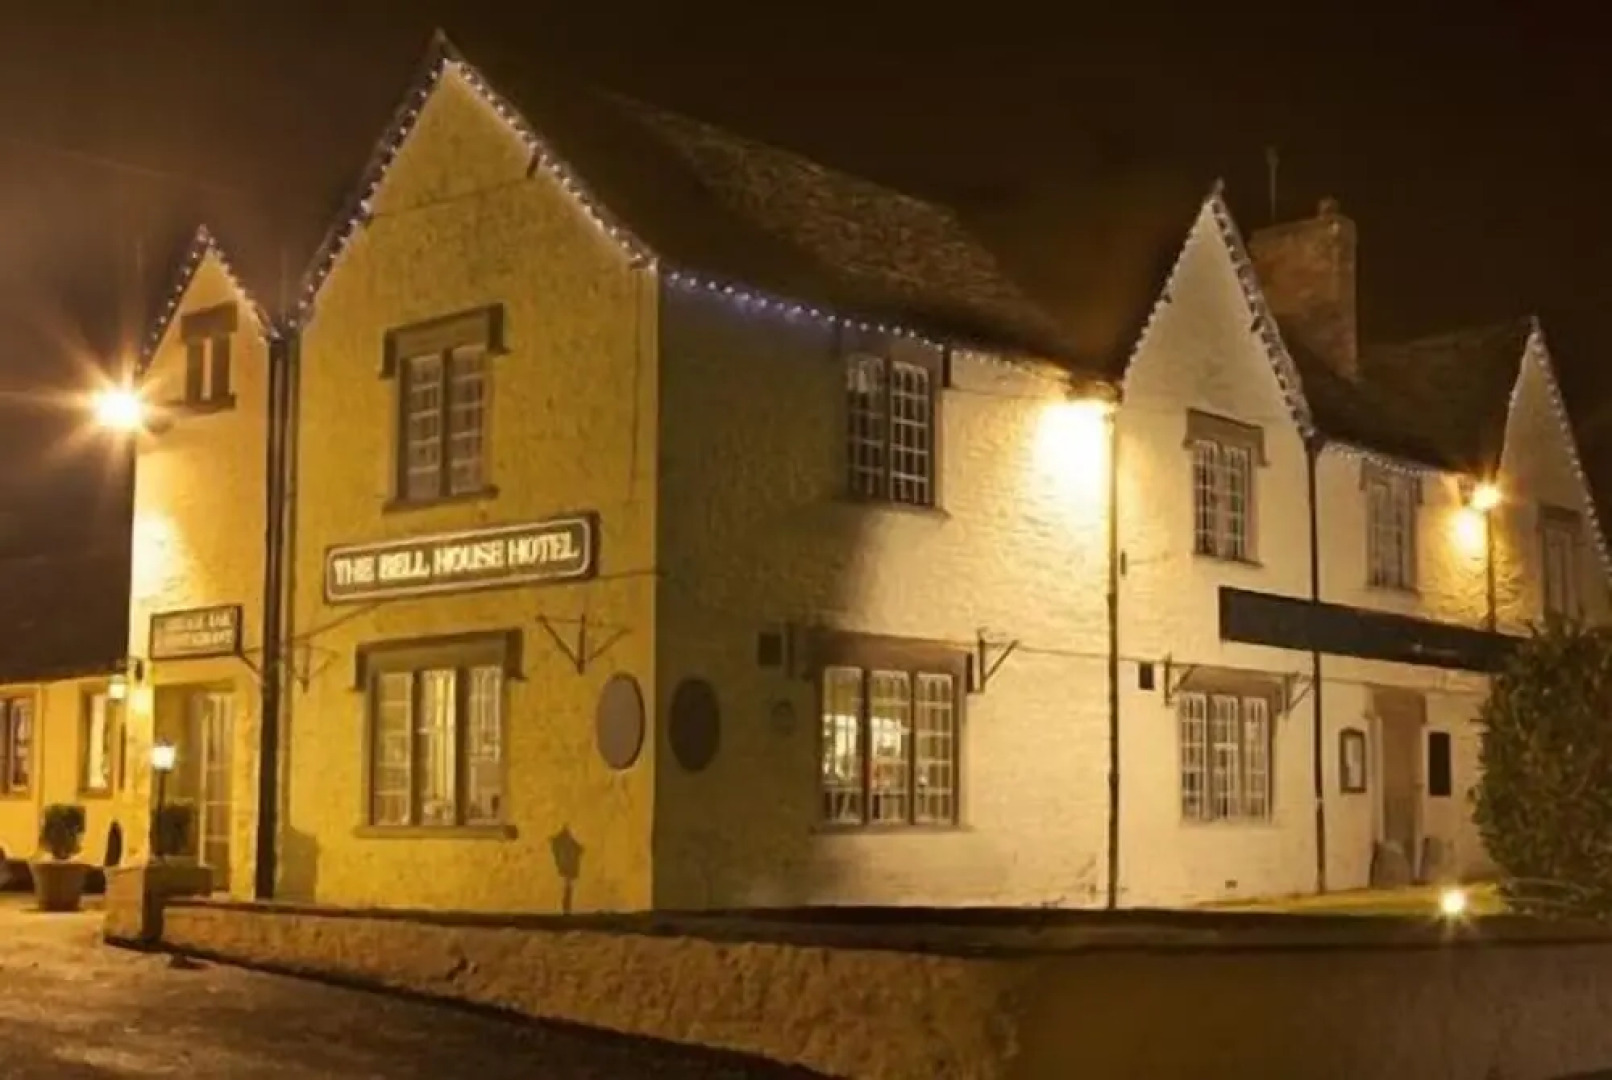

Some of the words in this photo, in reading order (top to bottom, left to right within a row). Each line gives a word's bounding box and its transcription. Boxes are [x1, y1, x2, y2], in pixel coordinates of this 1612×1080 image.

[334, 558, 374, 585] THE
[379, 551, 430, 580] BELL
[434, 540, 505, 575] HOUSE
[508, 532, 580, 566] HOTEL
